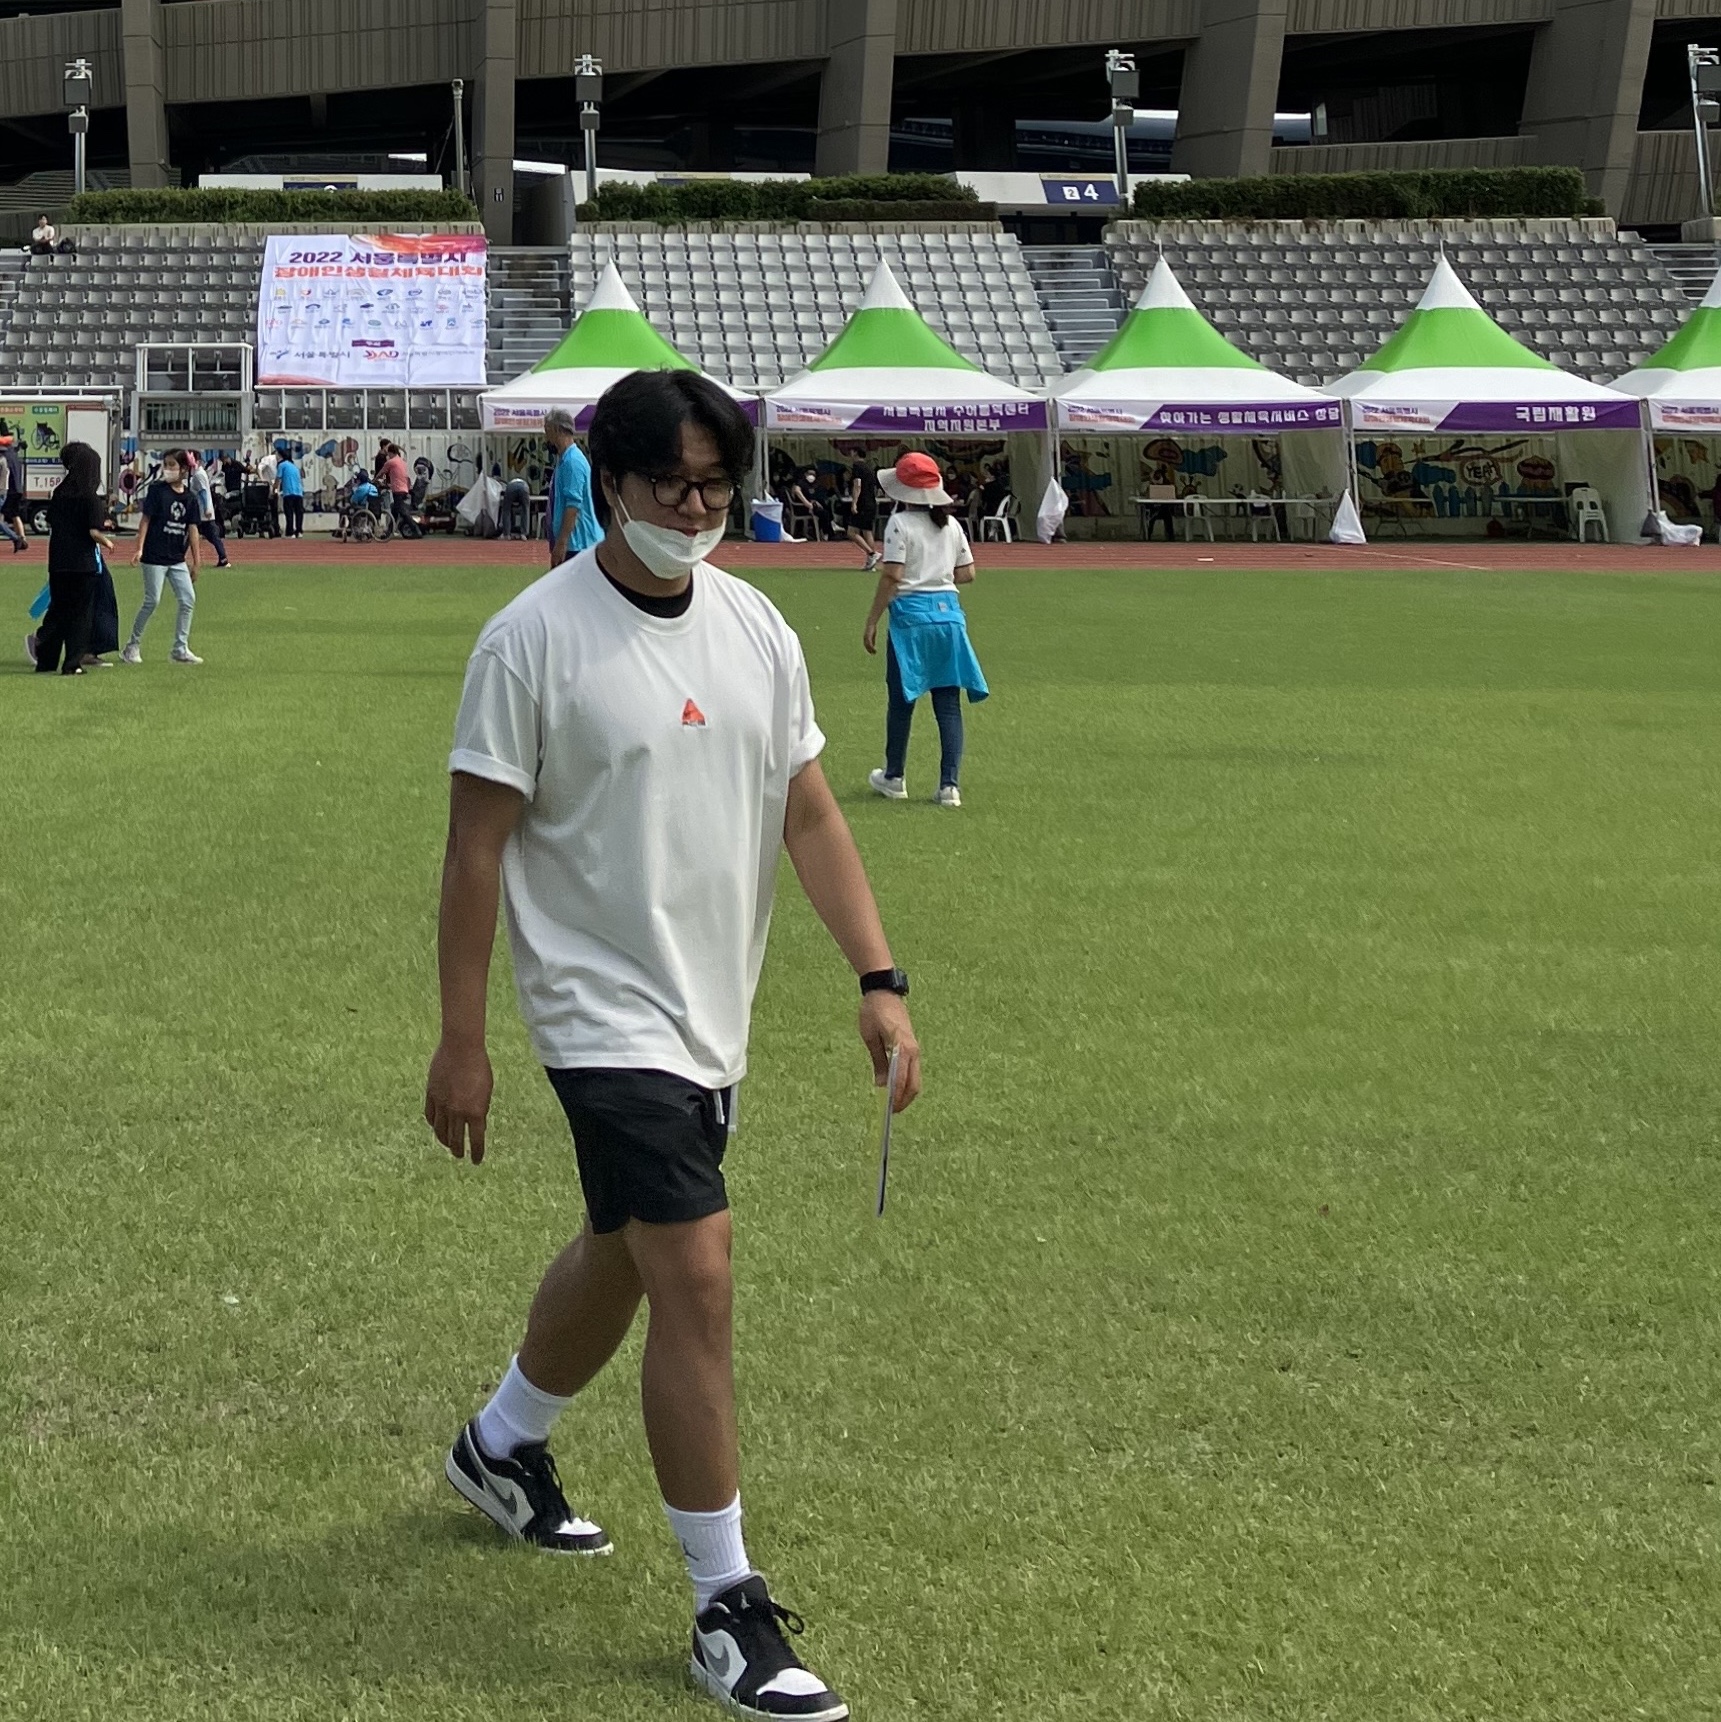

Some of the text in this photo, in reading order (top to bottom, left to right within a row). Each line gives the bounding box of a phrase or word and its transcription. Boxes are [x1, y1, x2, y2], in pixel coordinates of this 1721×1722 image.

[1084, 183, 1099, 200] 4
[289, 251, 343, 264] 2022
[1516, 406, 1596, 422] 국립재활원
[1465, 461, 1495, 478] YEAH
